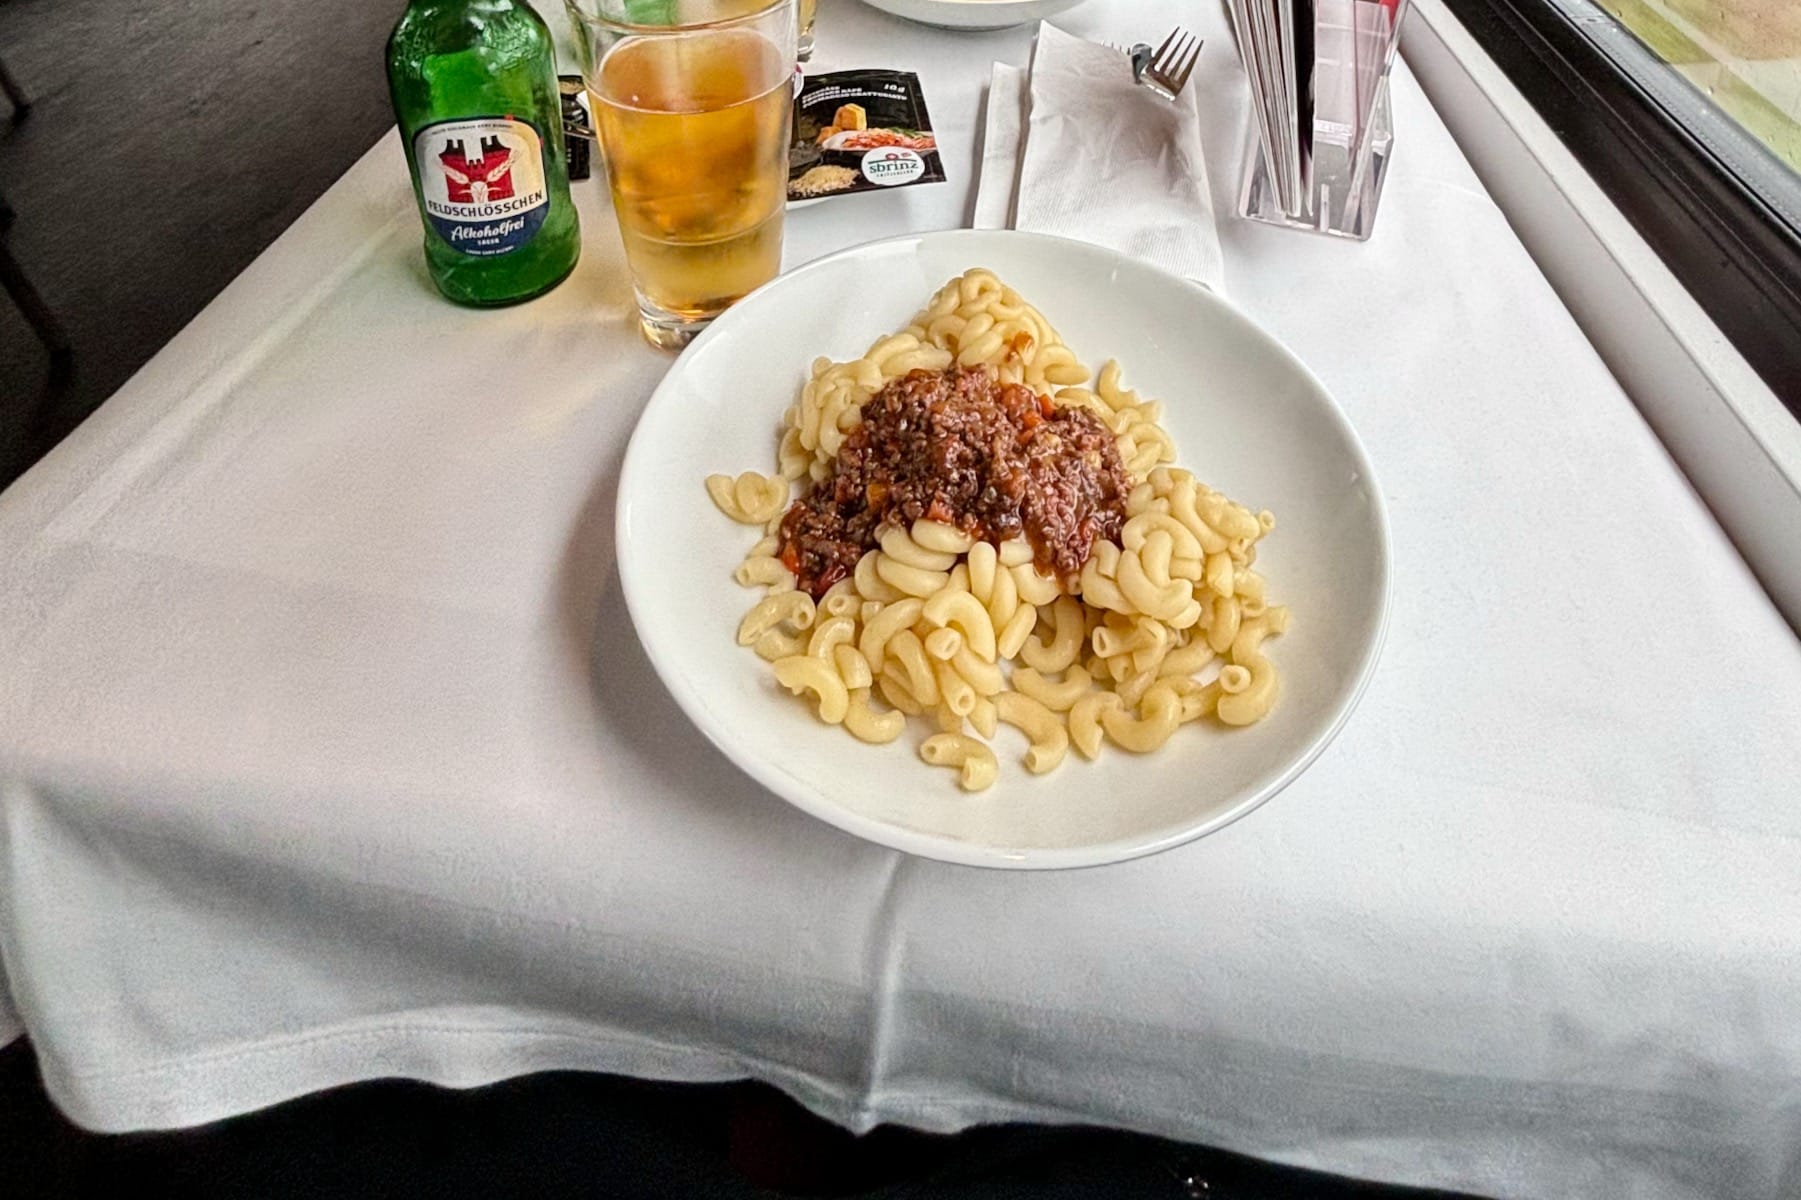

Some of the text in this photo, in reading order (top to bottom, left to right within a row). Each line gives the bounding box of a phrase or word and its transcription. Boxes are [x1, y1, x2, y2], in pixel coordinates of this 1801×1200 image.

[868, 162, 919, 175] sbrinz
[427, 190, 543, 218] FELDSCHLÖSSCHEN
[450, 216, 525, 242] Alkoholfrei
